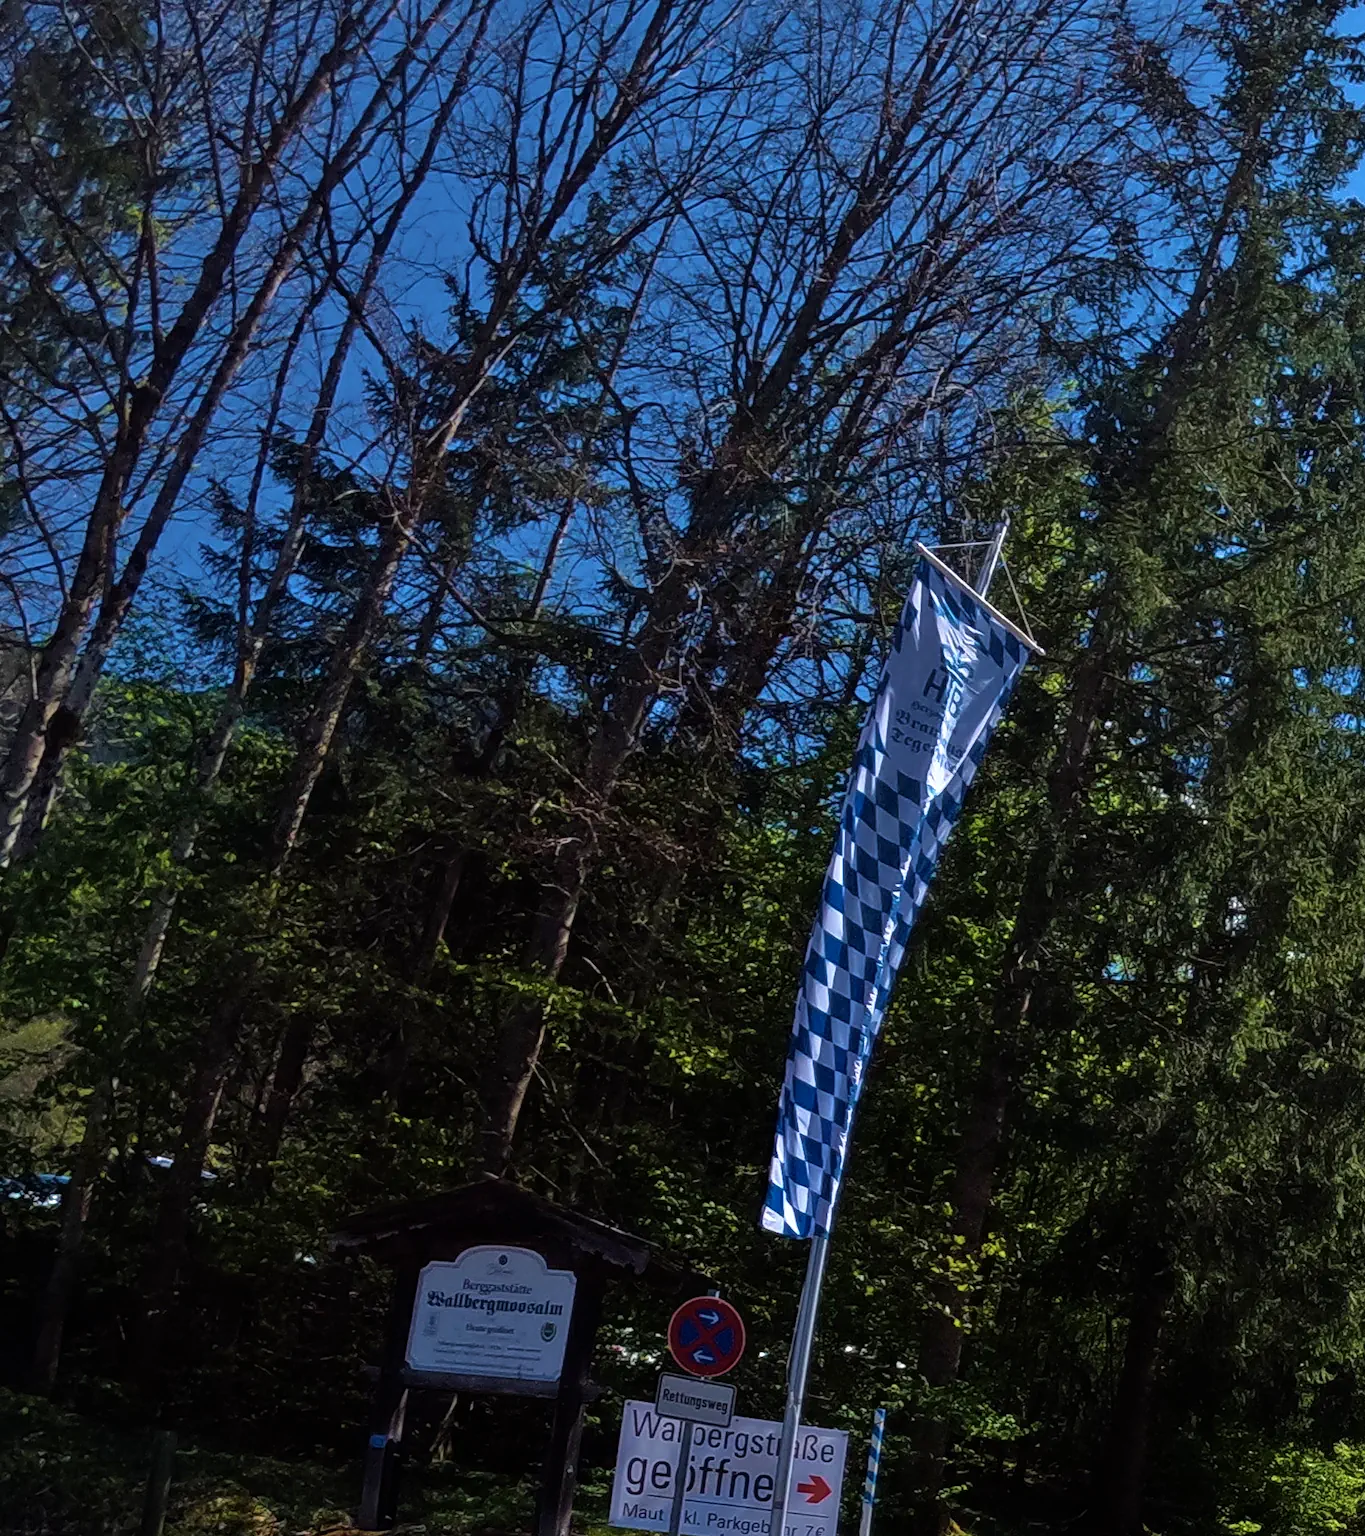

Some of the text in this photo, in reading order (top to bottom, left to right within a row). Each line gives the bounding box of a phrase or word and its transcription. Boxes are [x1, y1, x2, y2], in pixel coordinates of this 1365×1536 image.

[463, 1278, 533, 1295] Berggaststätte
[427, 1290, 563, 1316] Wallbergmoosalm
[663, 1389, 728, 1415] Rettungsweg
[633, 1408, 835, 1464] Walbergstrße
[626, 1455, 774, 1503] geöffne
[622, 1503, 664, 1522] Maut
